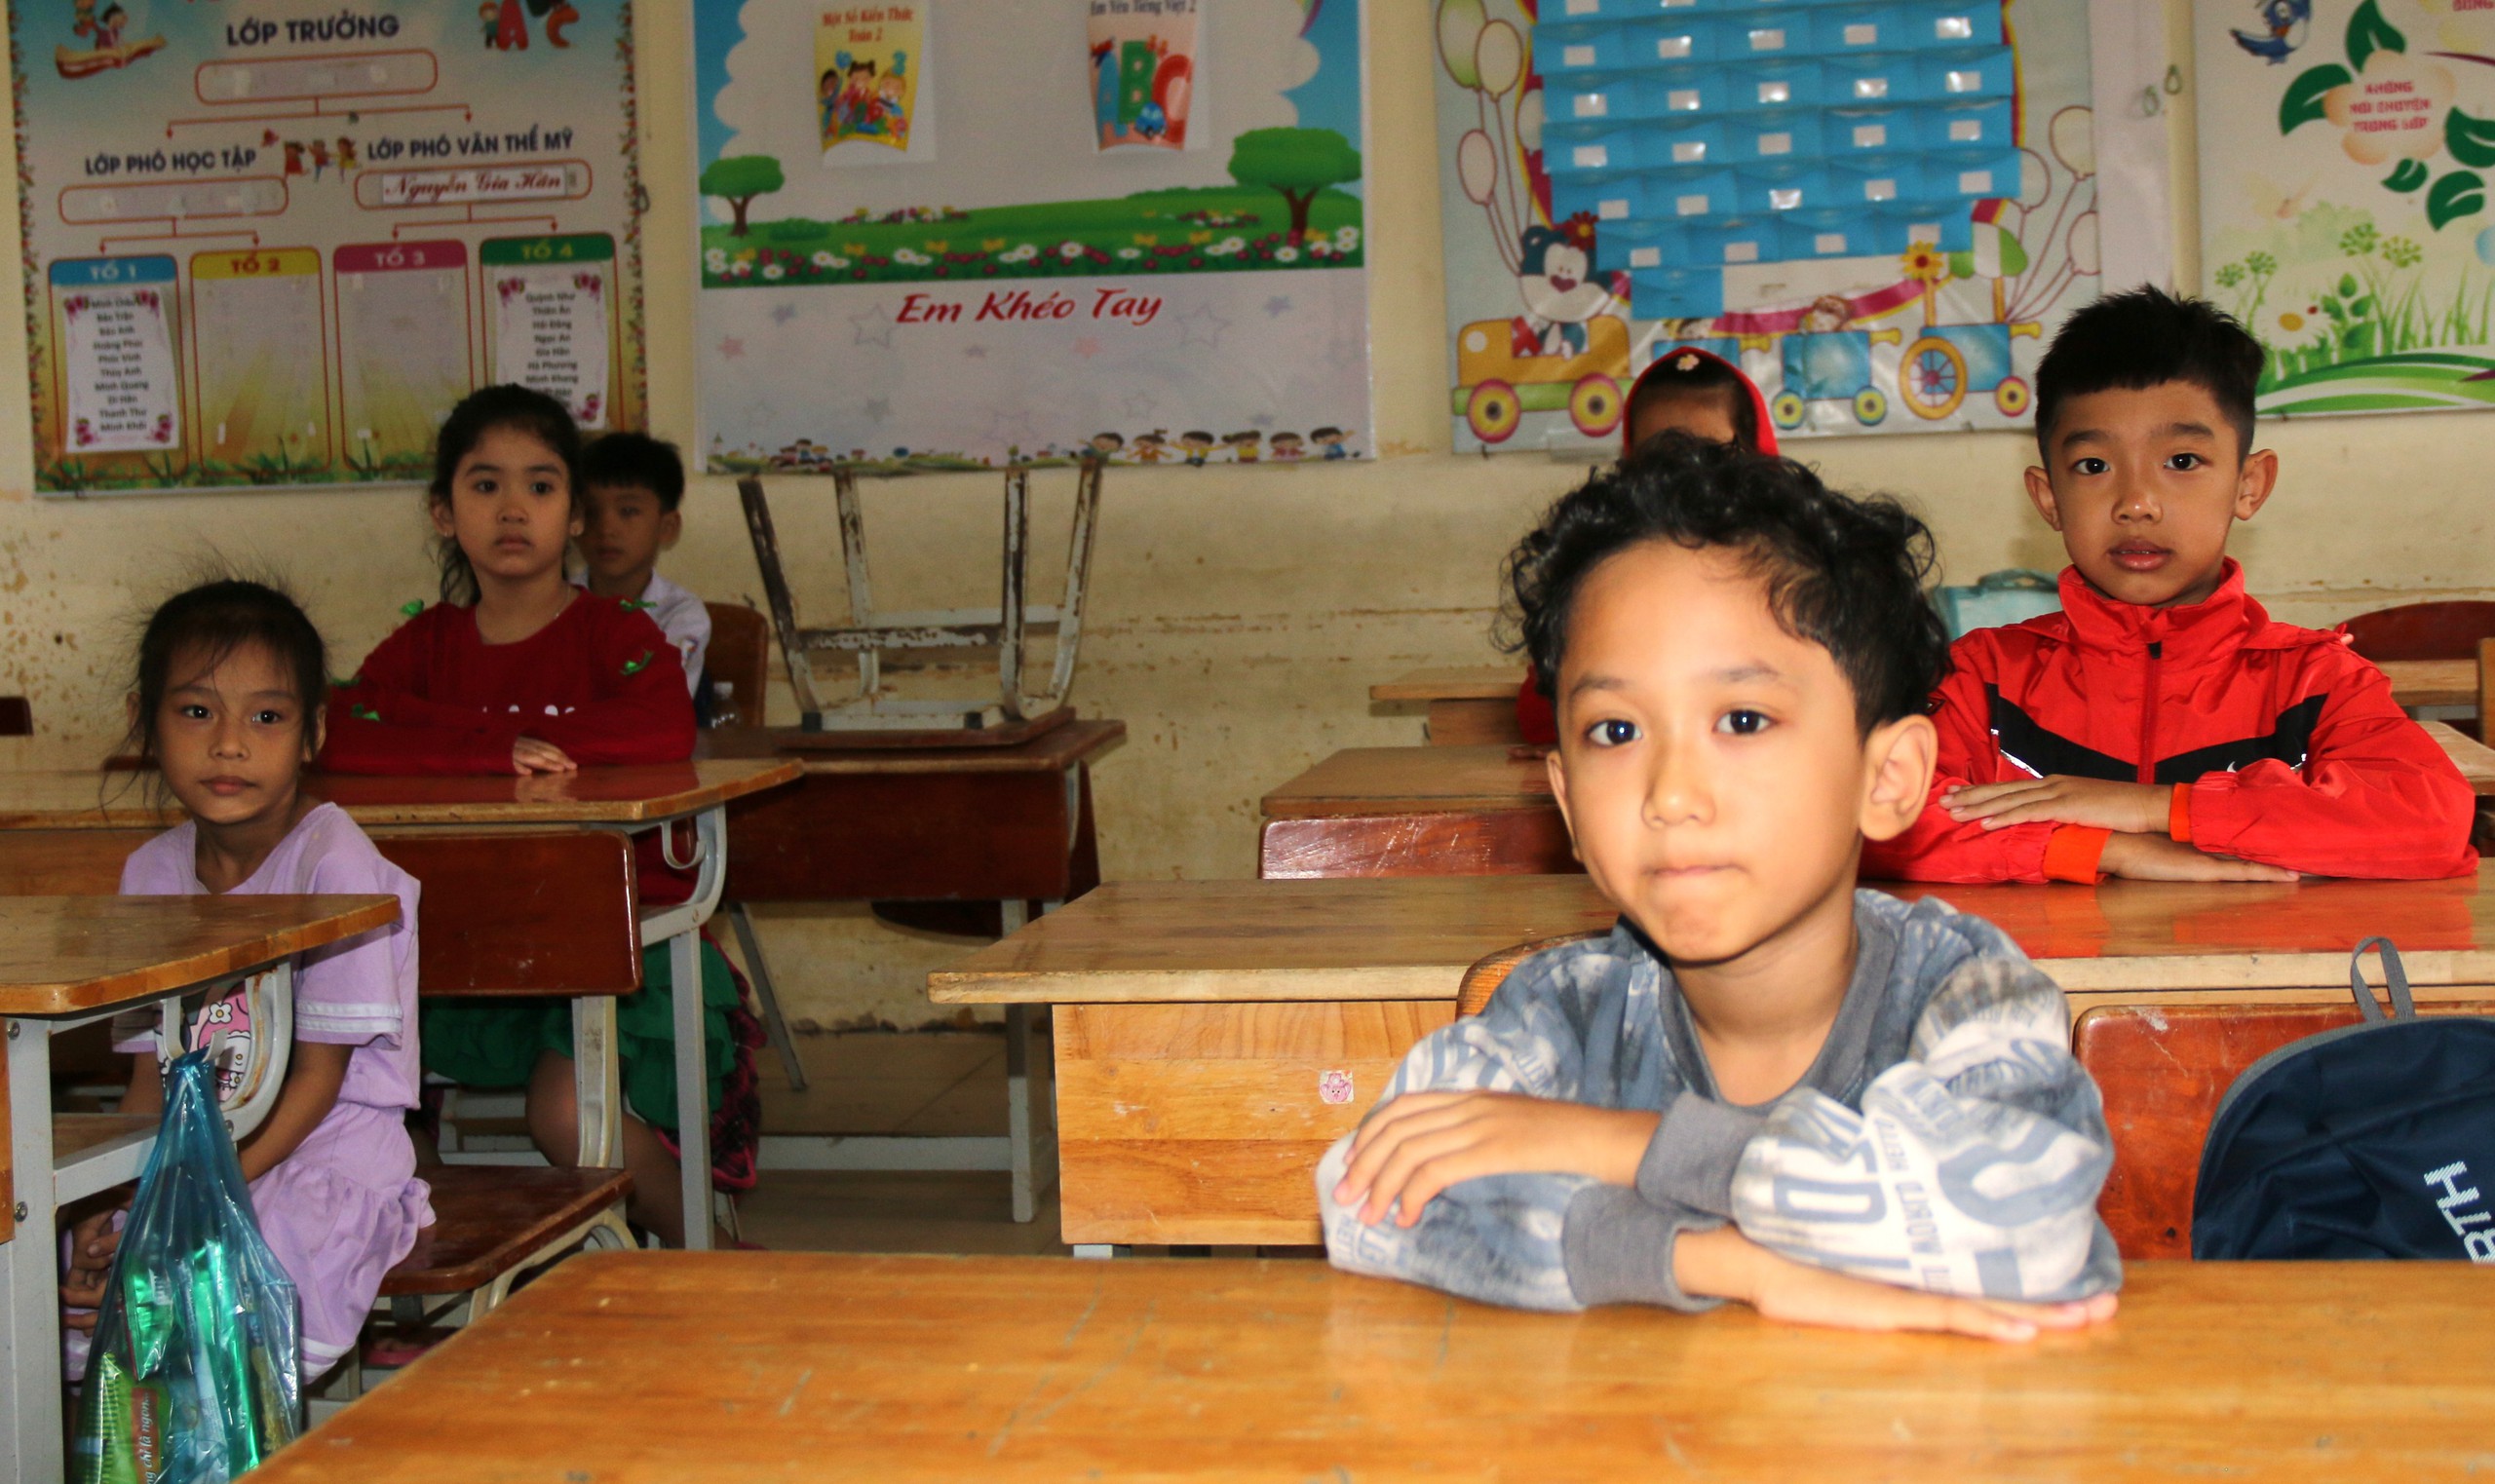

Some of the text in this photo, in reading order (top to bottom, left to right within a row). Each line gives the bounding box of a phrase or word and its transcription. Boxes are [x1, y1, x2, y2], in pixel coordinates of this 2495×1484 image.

[226, 9, 401, 46] LỚP TRƯỞNG
[367, 137, 404, 161] LỚP
[410, 133, 451, 159] PHÓ
[457, 130, 499, 155] VĂN
[543, 127, 574, 151] MỸ
[85, 143, 256, 175] LỚP PHÓ HỌC TẬP
[413, 249, 425, 266] 3
[559, 243, 573, 258] 4
[129, 263, 136, 278] 1
[268, 257, 280, 273] 2
[896, 286, 1163, 326] Em Khéo Tay
